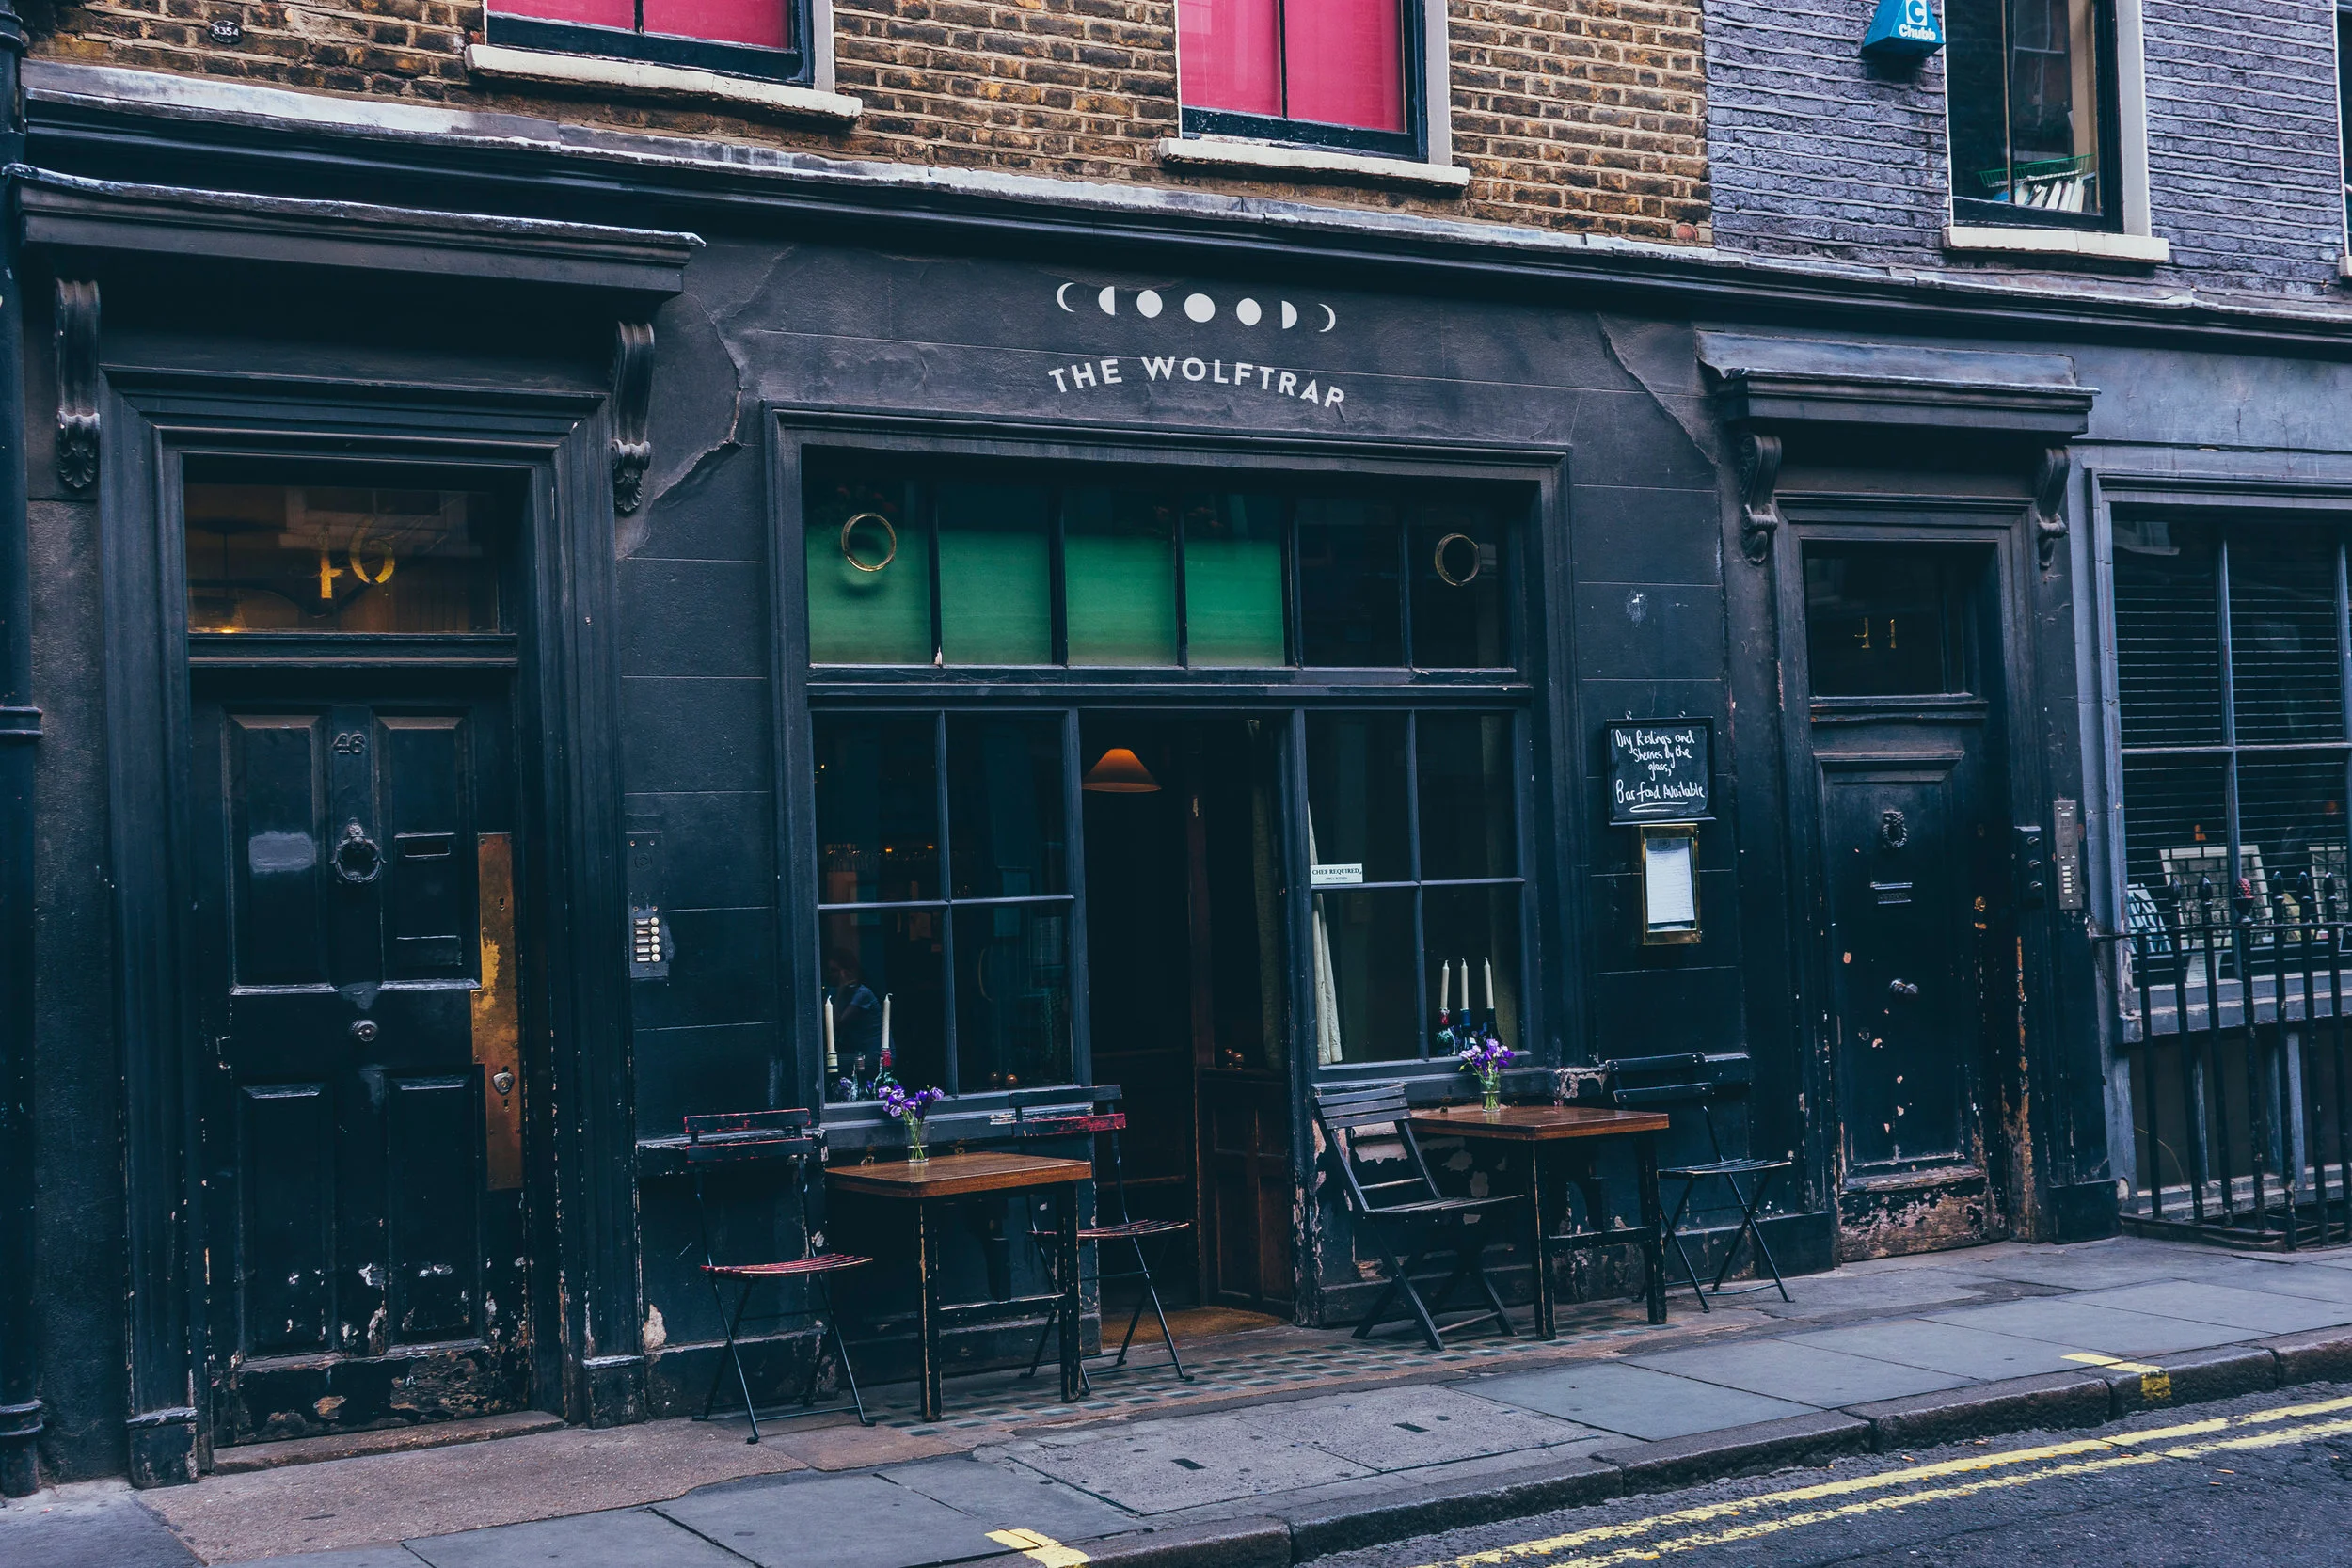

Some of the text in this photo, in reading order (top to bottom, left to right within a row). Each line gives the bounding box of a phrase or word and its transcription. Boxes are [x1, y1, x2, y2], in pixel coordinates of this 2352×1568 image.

[1899, 24, 1936, 41] Chubb
[1047, 356, 1345, 408] THE WOLFTRAP
[330, 732, 366, 753] 46
[1615, 729, 1633, 753] Dry
[1675, 729, 1695, 744] and
[1632, 744, 1692, 768] Sherries by the
[1615, 779, 1635, 804] Bar
[1662, 781, 1706, 800] Available
